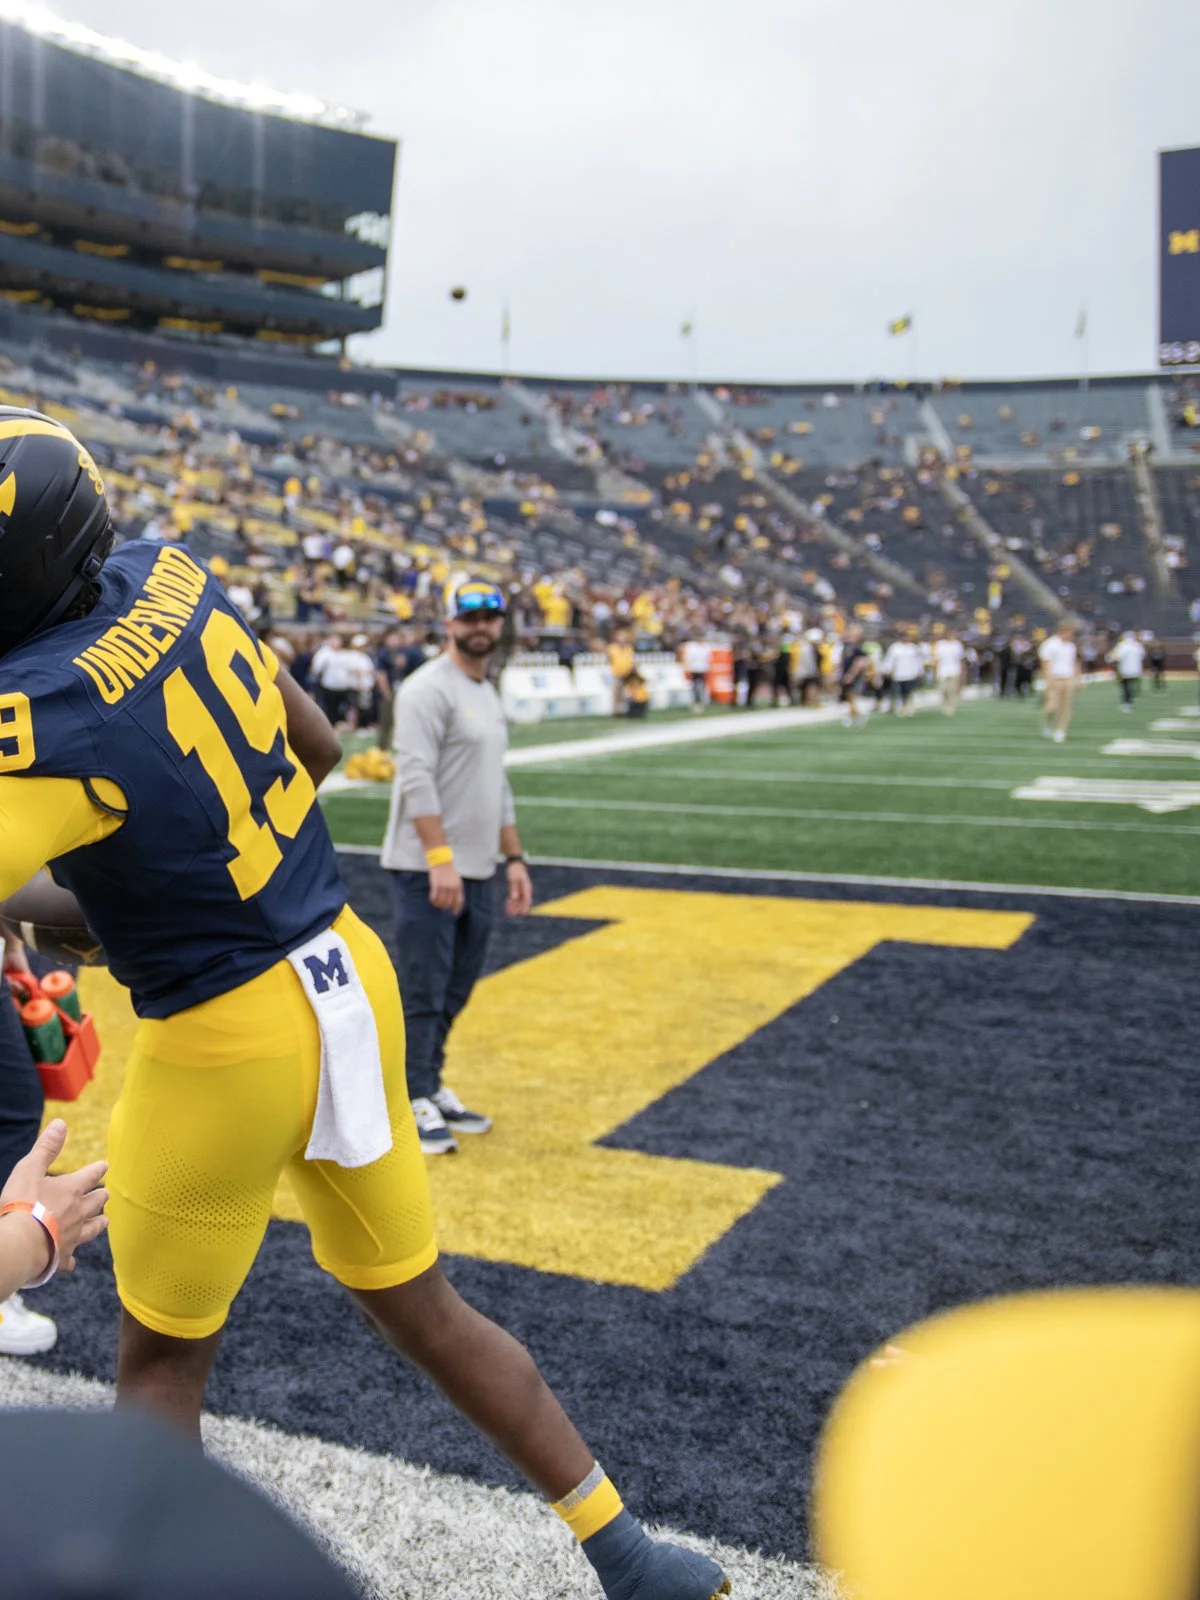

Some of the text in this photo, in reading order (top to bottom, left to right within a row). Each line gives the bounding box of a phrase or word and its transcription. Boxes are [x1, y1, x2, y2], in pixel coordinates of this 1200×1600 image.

[72, 546, 208, 704] UNDERWOOD
[162, 607, 316, 902] 19
[303, 947, 349, 994] M
